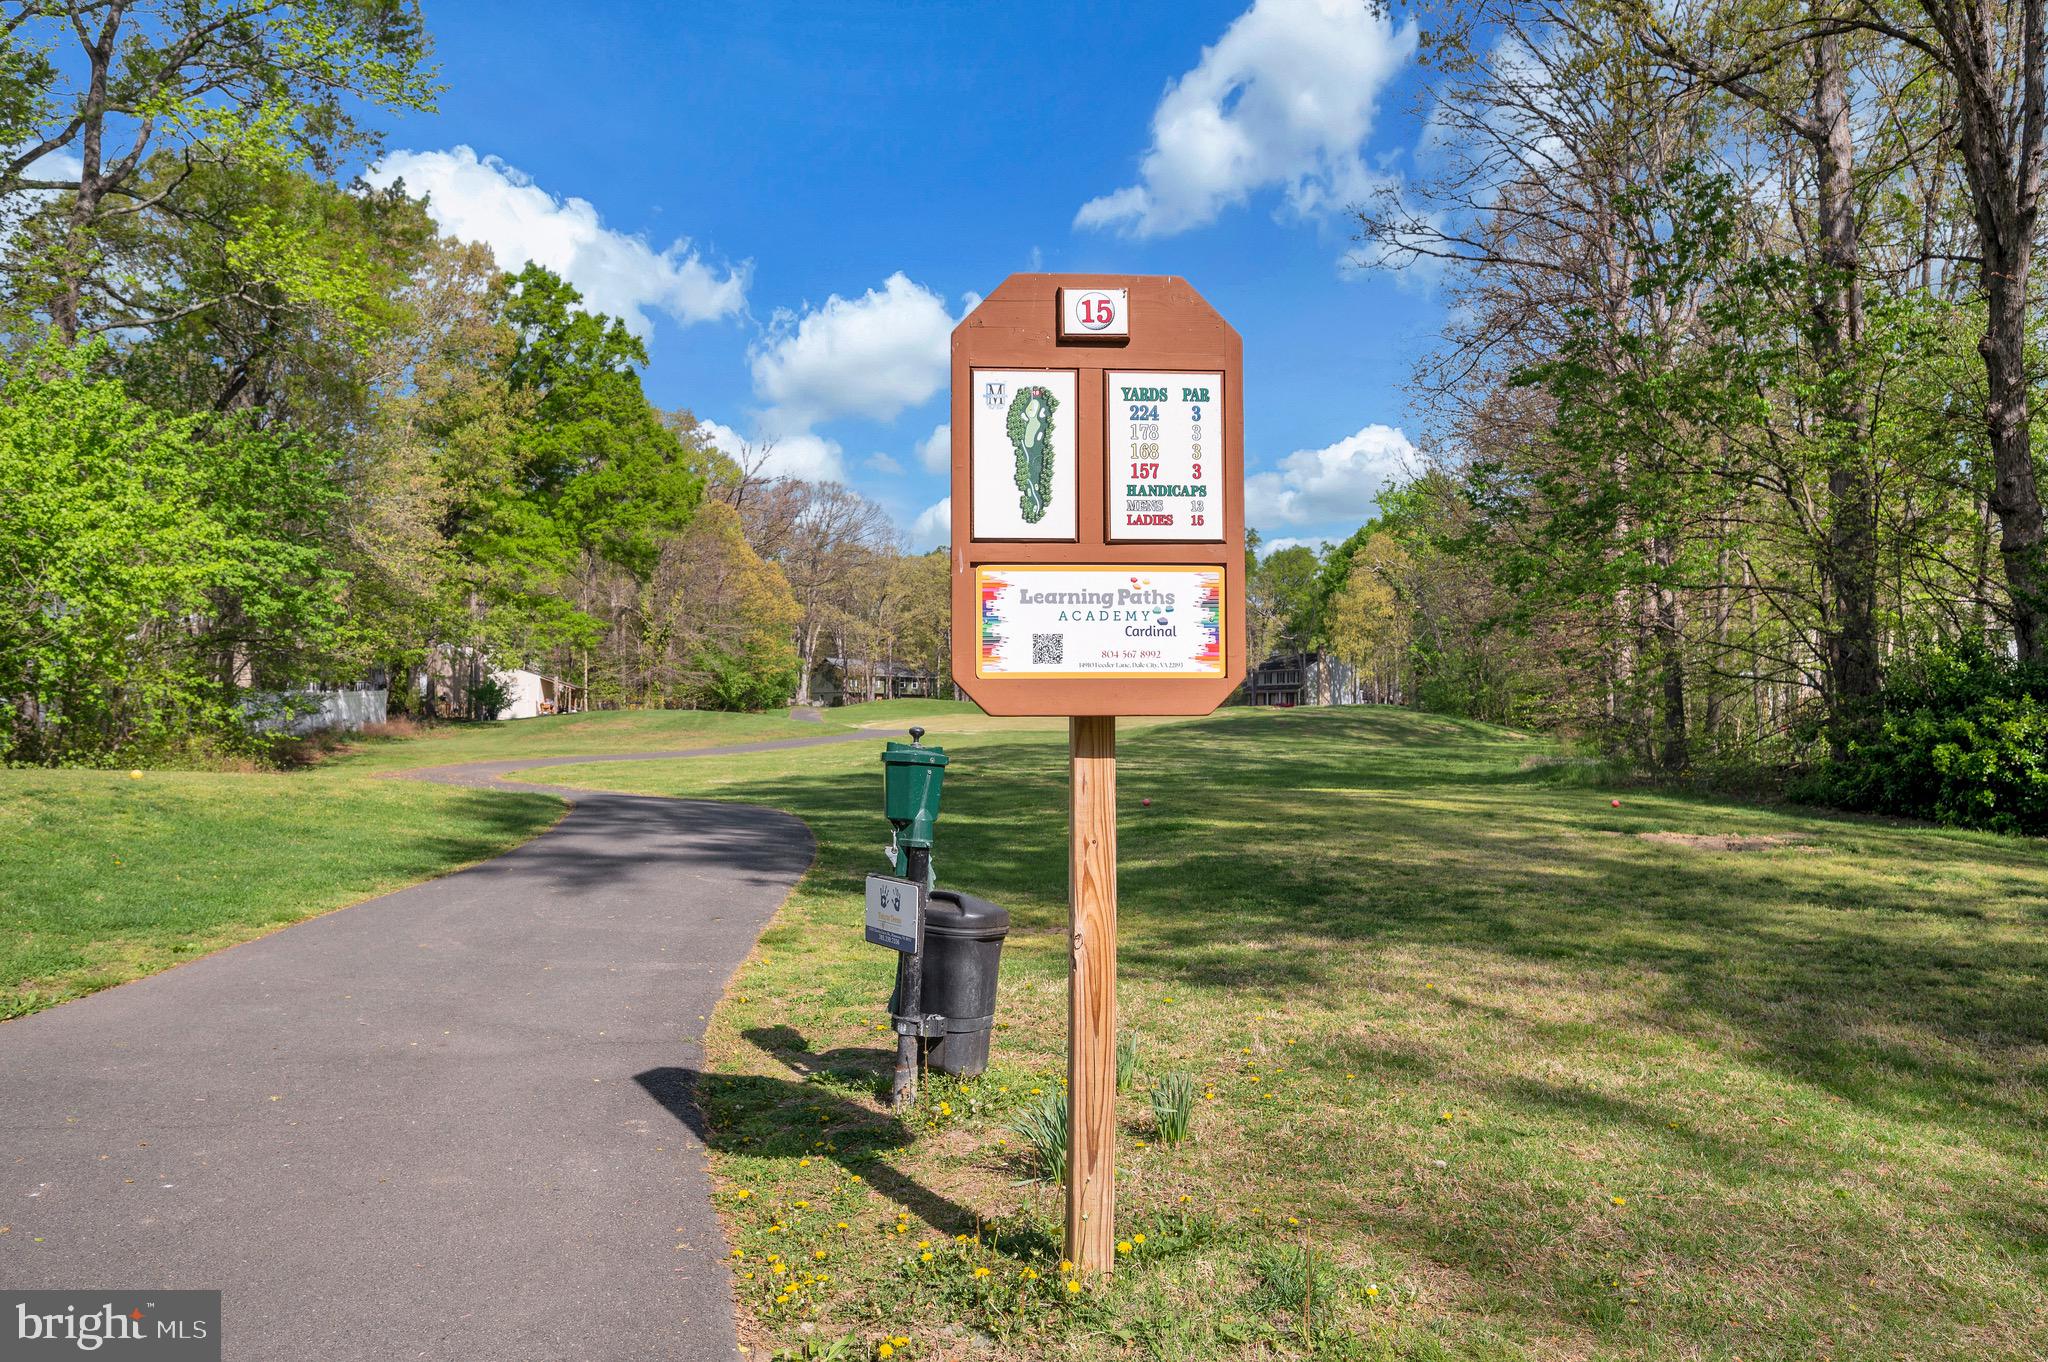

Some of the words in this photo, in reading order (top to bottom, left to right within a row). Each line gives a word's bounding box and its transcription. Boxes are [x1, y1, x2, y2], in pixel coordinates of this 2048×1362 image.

[1082, 299, 1113, 323] 15
[1121, 387, 1168, 402] YARDS
[1182, 387, 1210, 402] PAR
[1129, 405, 1160, 421] 224
[1191, 405, 1201, 422] 3
[1130, 424, 1160, 440] 178
[1191, 424, 1201, 441] 3
[1130, 443, 1160, 460] 168
[1192, 443, 1202, 460] 3
[1130, 463, 1160, 479] 157
[1192, 463, 1202, 480] 3
[1126, 485, 1207, 497] HANDICAPS
[1126, 500, 1164, 512] MENS
[1190, 500, 1204, 512] 13
[1127, 514, 1174, 526] LADIES
[1191, 514, 1204, 526] 15
[1019, 588, 1114, 609] Learning
[1117, 588, 1175, 605] Paths
[1058, 610, 1150, 621] ACADEMY
[1125, 625, 1177, 637] Cardinal
[1101, 650, 1119, 659] 804
[1122, 650, 1137, 659] 567
[1140, 650, 1161, 659] 8992
